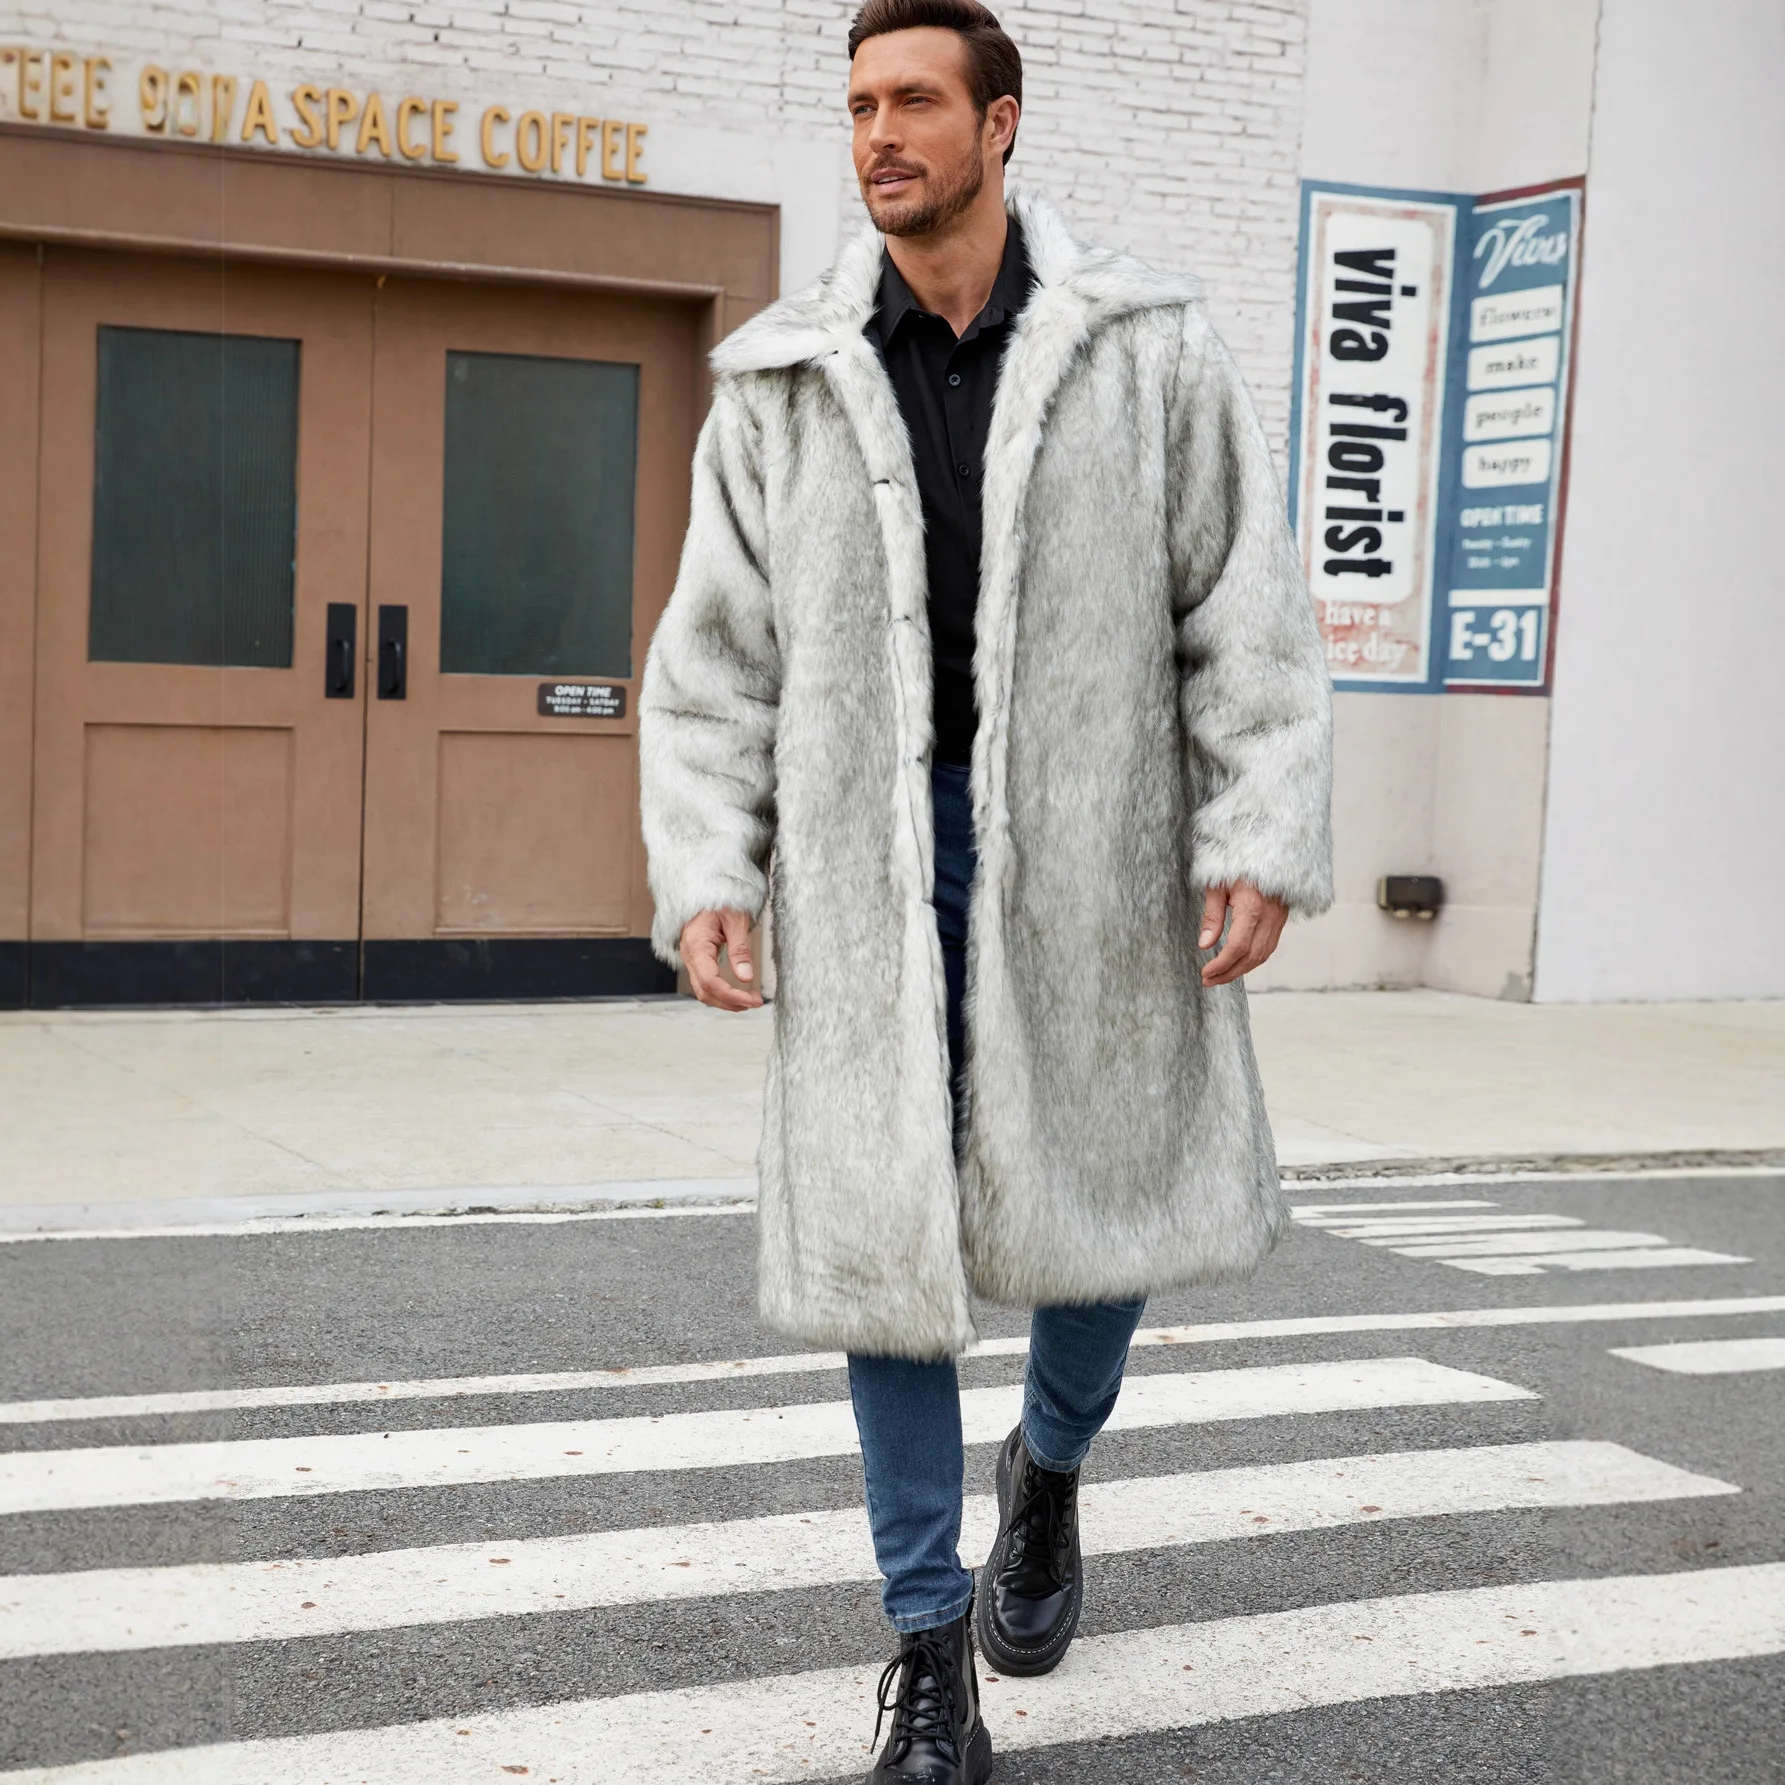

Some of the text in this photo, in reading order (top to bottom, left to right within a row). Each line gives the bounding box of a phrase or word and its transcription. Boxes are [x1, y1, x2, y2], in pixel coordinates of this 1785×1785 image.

[291, 83, 460, 164] SPACE
[480, 105, 648, 184] COFFEE
[1484, 353, 1540, 373] make
[1323, 248, 1418, 578] viva florist
[1475, 401, 1545, 429] people
[1477, 455, 1533, 476] happy
[1460, 503, 1545, 529] OPEN TIME
[1324, 600, 1377, 627] have
[1449, 608, 1540, 662] E-31
[555, 685, 612, 698] OPEN TIME
